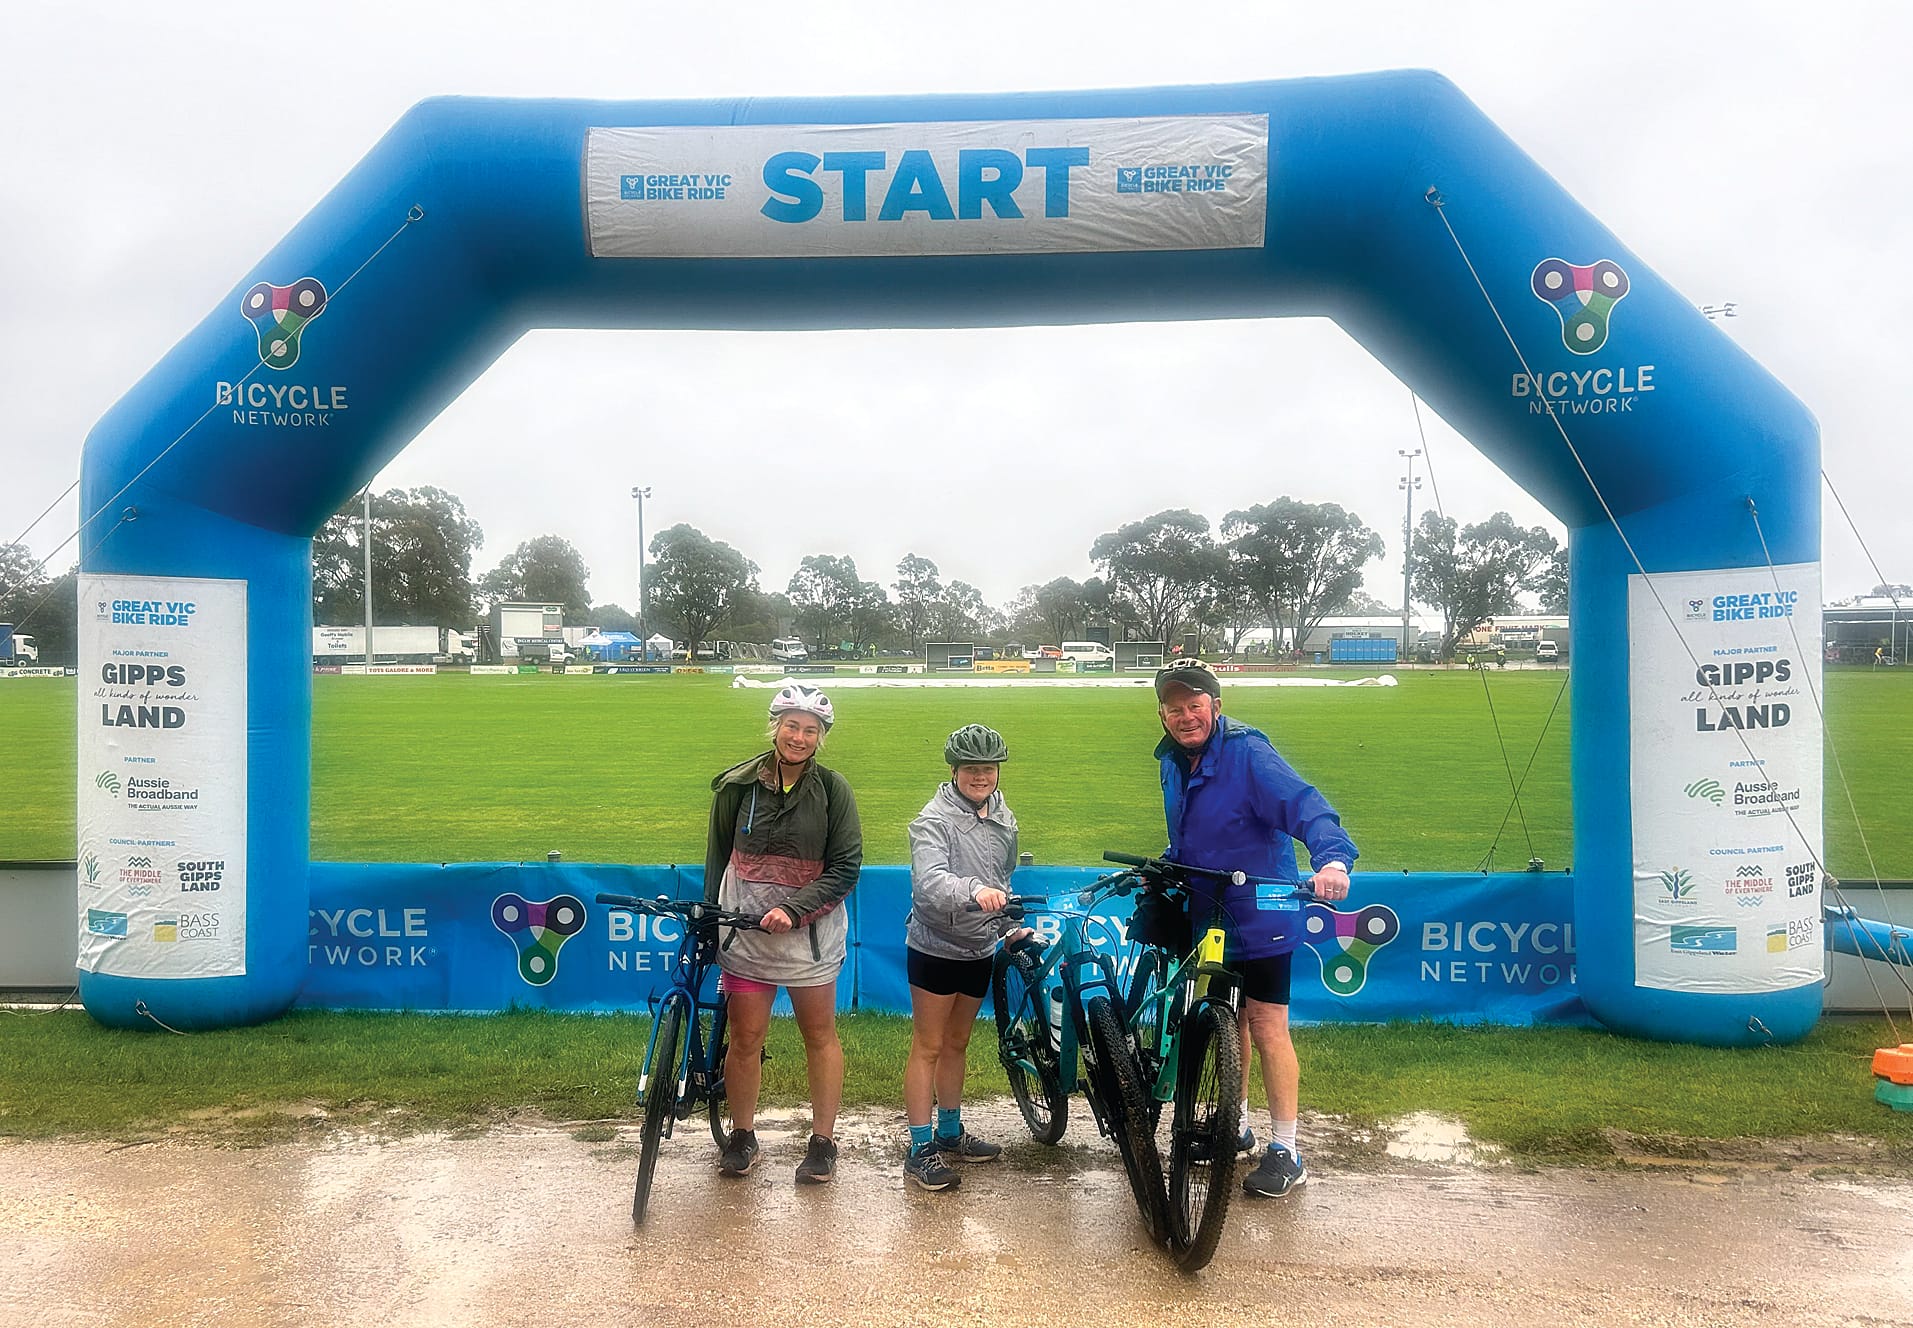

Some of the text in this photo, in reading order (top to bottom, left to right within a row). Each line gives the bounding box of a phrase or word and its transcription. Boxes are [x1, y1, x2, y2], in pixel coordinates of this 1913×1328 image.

[1144, 165, 1232, 179] GREAT VIC
[646, 175, 732, 186] GREAT VIC
[759, 146, 1090, 223] START
[1144, 179, 1225, 192] BIKE RIDE
[646, 188, 725, 200] BIKE RIDE
[1512, 365, 1655, 397] BICYCLE
[216, 381, 349, 410] BICYCLE
[1529, 397, 1633, 415] NETWORK
[233, 410, 330, 427] NETWORK
[1712, 591, 1798, 608] GREAT VIC
[112, 600, 196, 614] GREAT VIC
[1713, 604, 1793, 622] BIKE RIDE
[112, 612, 146, 624] BIKE
[149, 614, 188, 626] RIDE
[1744, 646, 1777, 654] PARTNER
[102, 662, 186, 687] GIPPS
[1696, 659, 1791, 686] GIPPS
[140, 690, 152, 704] of
[156, 692, 199, 701] wonder
[1748, 689, 1761, 704] of
[1765, 687, 1800, 698] wonder
[102, 704, 186, 728] LAND
[1696, 703, 1790, 731] LAND
[128, 776, 170, 788] Aussie
[1734, 782, 1778, 793] Aussie
[128, 788, 198, 799] Broadband
[1734, 788, 1800, 804] Broadband
[1747, 845, 1784, 854] PARTNERS
[178, 861, 225, 872] SOUTH
[1786, 862, 1815, 877] SOUTH
[134, 870, 161, 878] MIDDLE
[180, 872, 222, 882] GIPPS
[1788, 873, 1815, 887] GIPPS
[181, 882, 220, 892] LAND
[1725, 878, 1774, 888] THE MIDDLE
[1789, 884, 1814, 898] LAND
[181, 913, 220, 928] BASS
[1789, 916, 1814, 936] BASS
[181, 927, 218, 938] COAST
[1789, 932, 1813, 947] COAST
